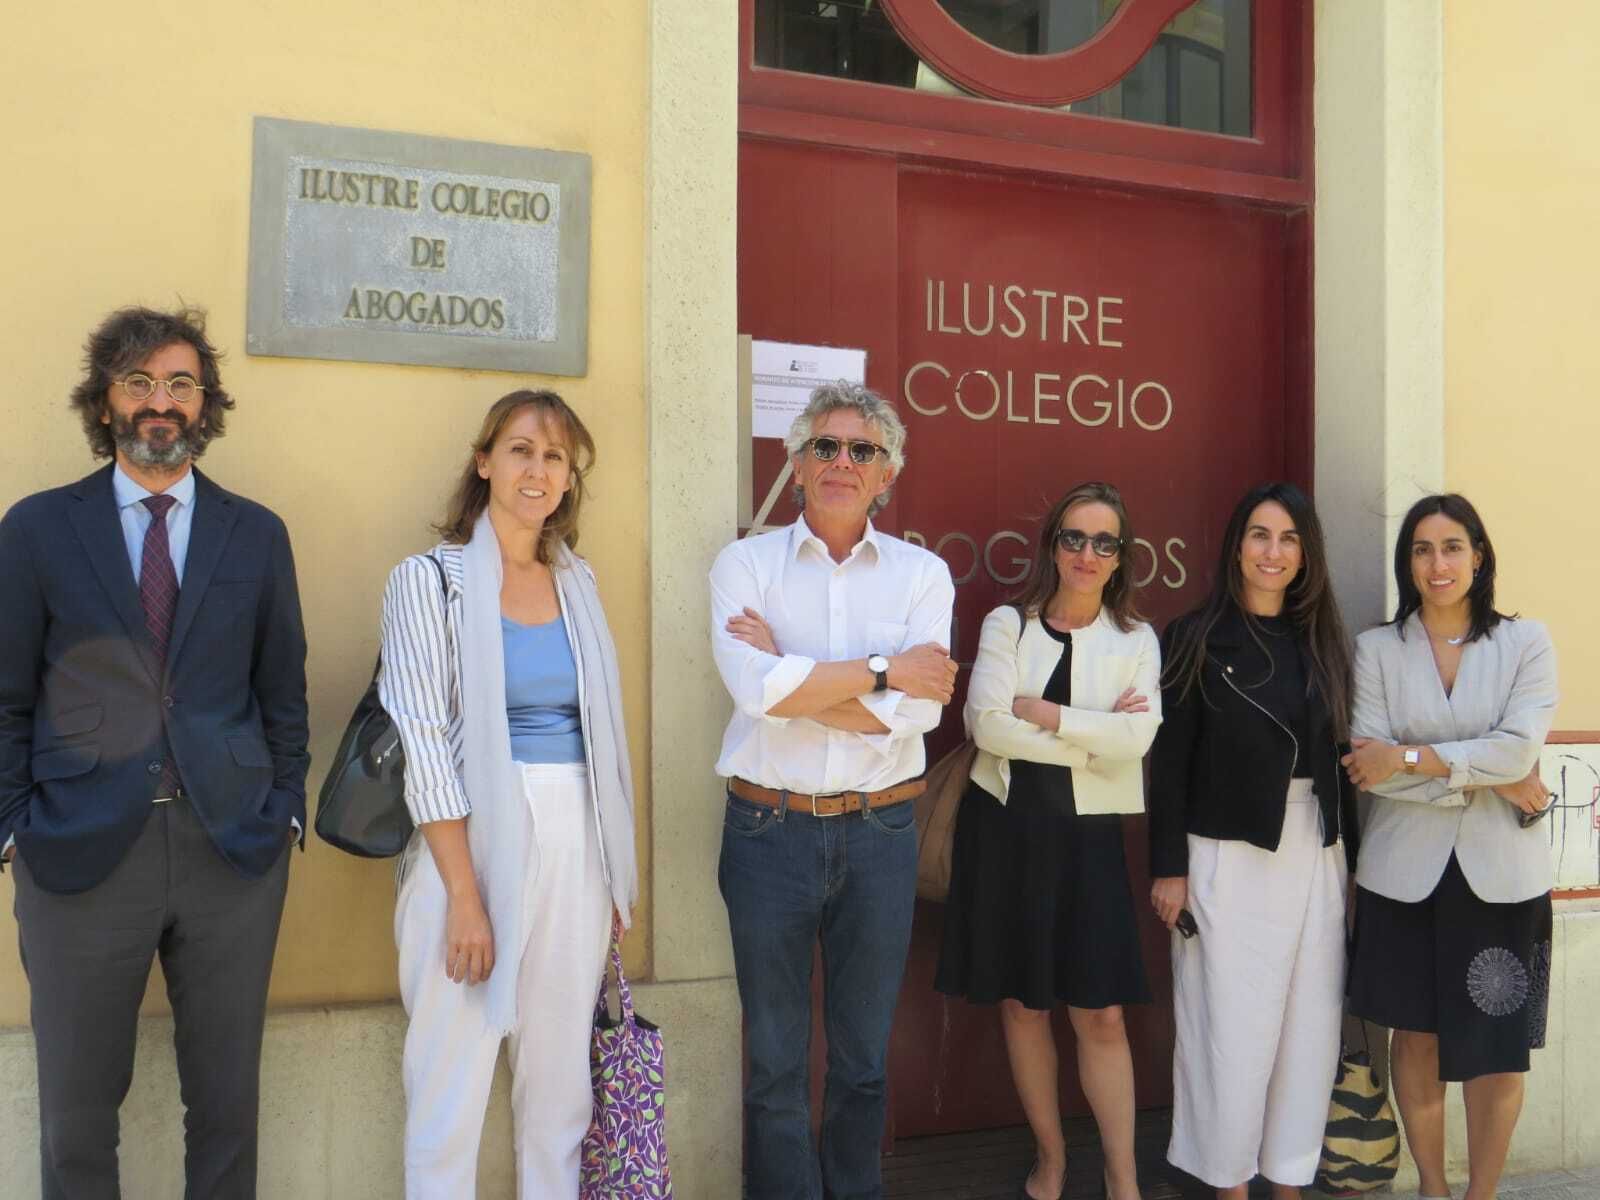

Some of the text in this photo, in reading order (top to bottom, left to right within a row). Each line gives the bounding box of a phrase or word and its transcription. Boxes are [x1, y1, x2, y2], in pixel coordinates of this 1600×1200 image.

[298, 168, 551, 223] ILUSTRE COLEGIO
[410, 236, 446, 269] DE
[343, 287, 506, 330] ABOGADOS
[927, 278, 1124, 348] ILUSTRE
[904, 361, 1173, 432] COLEGIO
